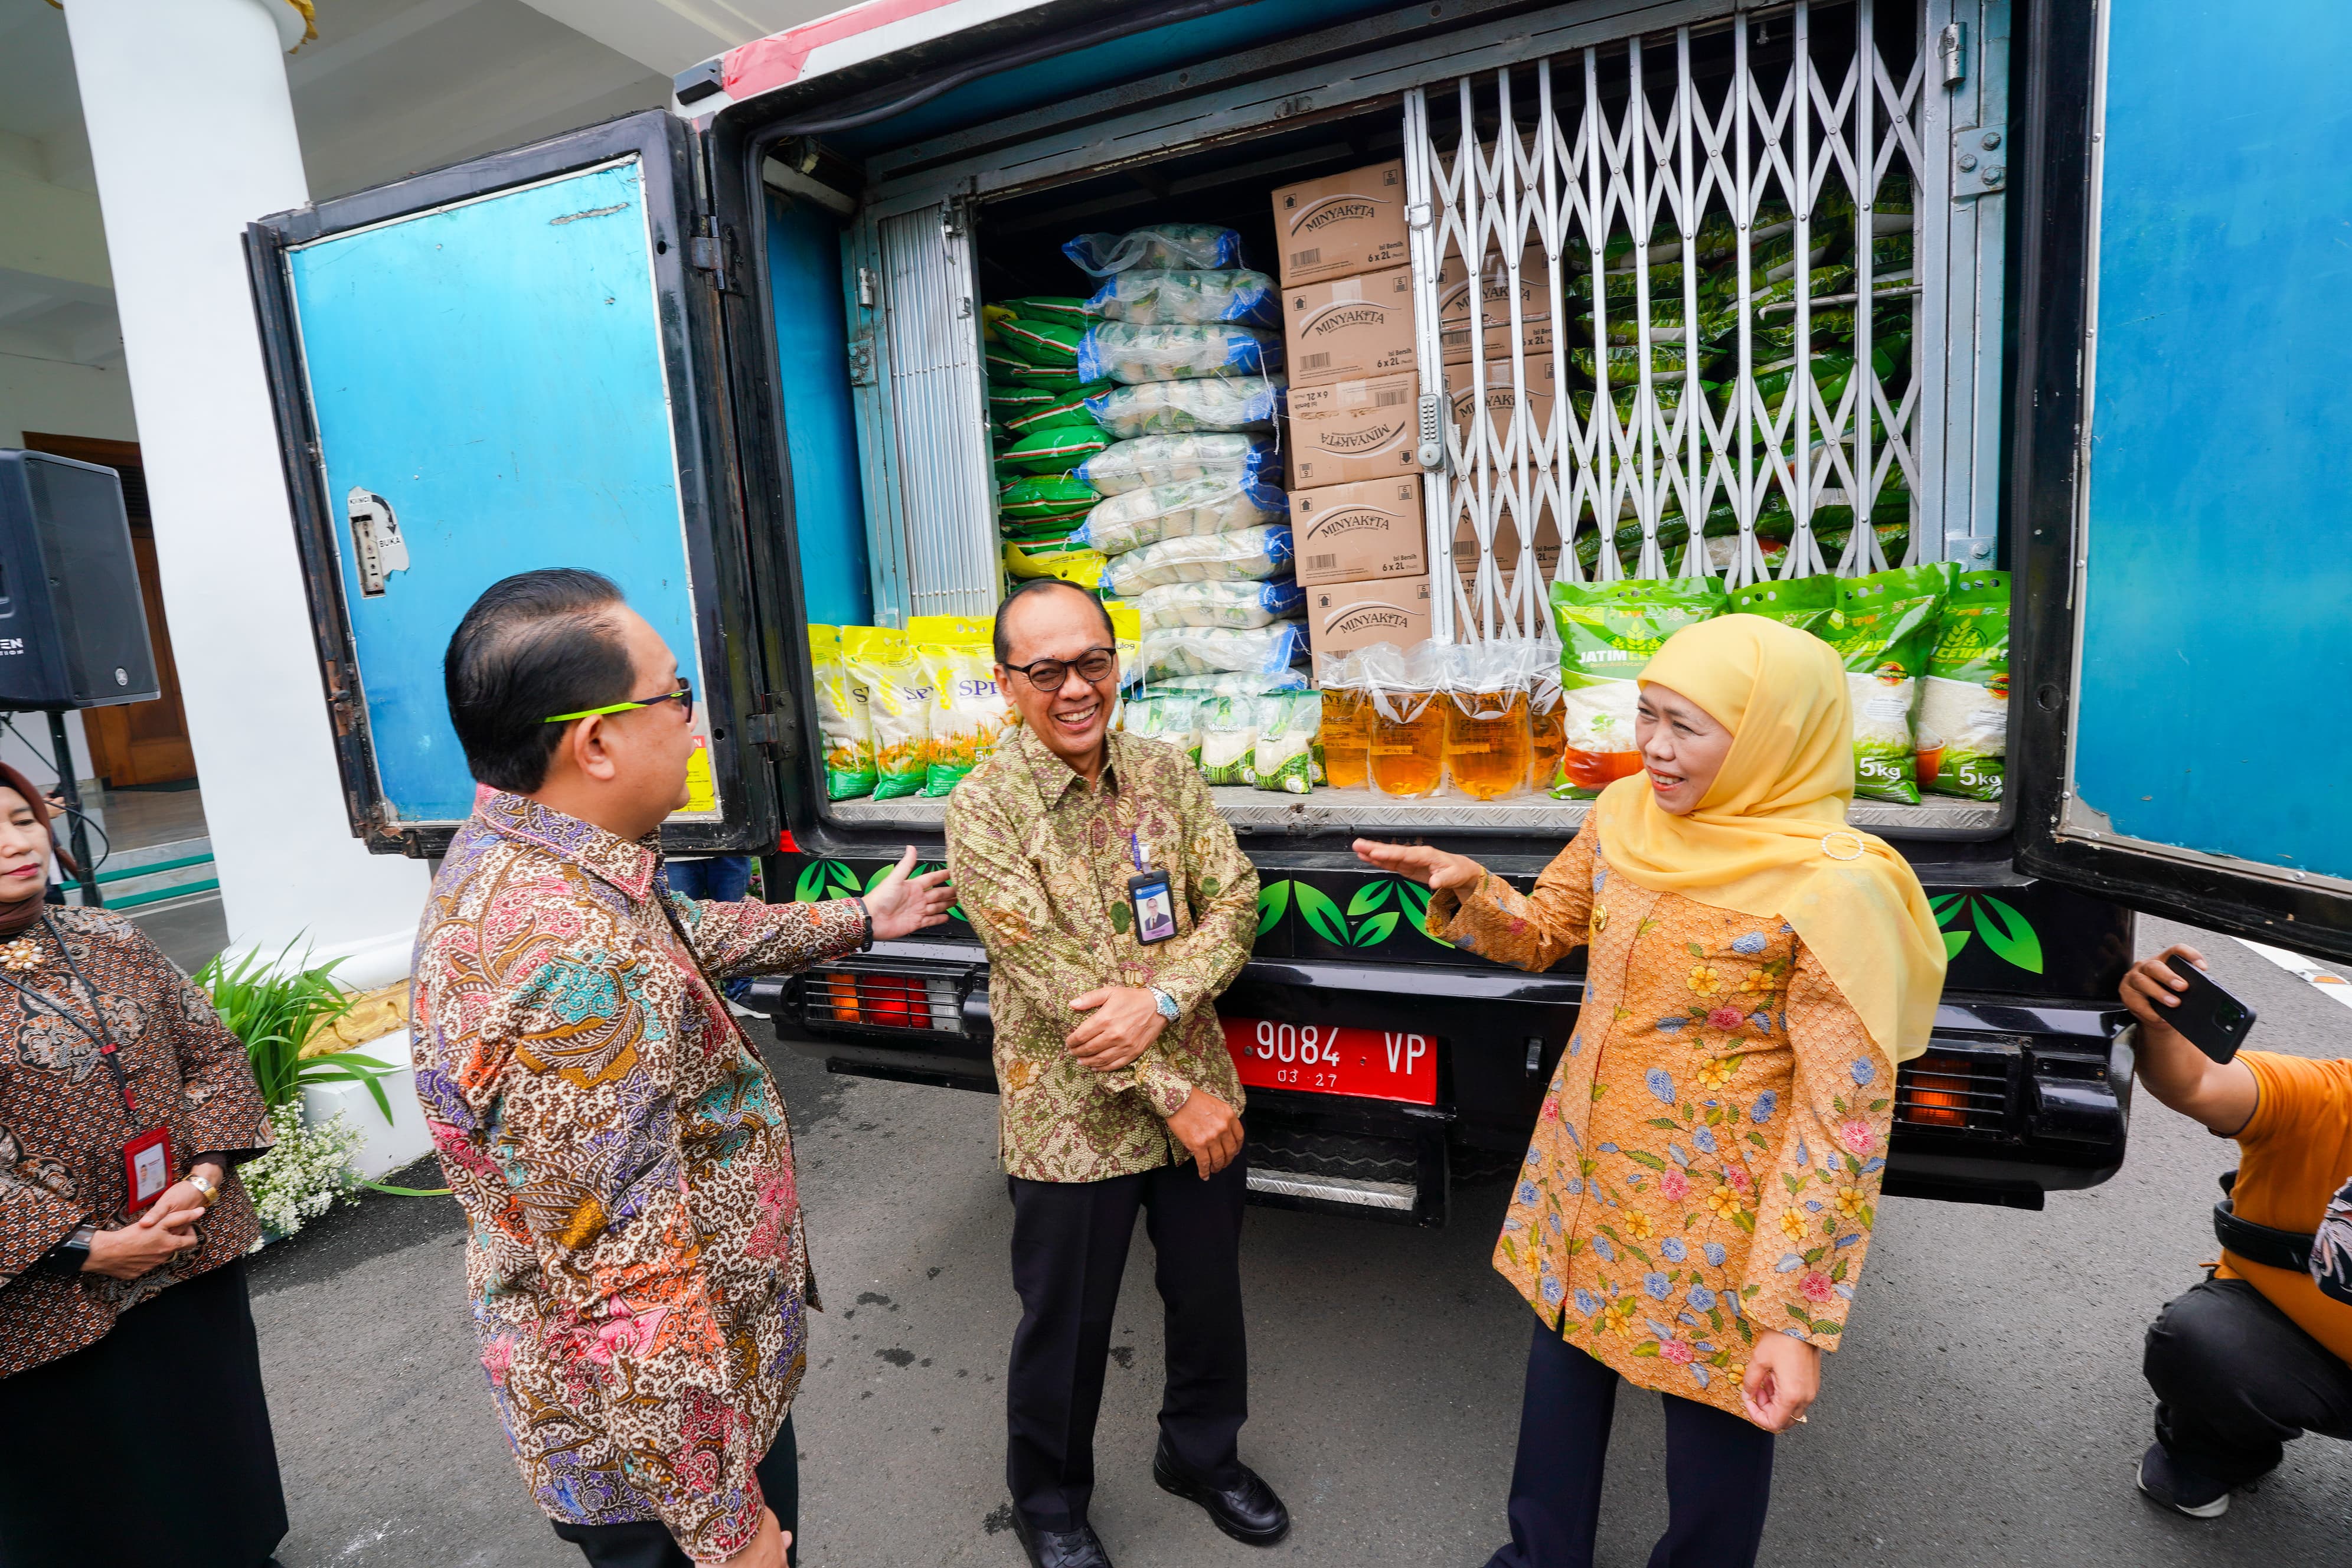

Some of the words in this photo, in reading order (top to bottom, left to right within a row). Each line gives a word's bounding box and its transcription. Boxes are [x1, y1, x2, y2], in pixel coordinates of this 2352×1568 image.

[1305, 205, 1375, 232] MINYAKITA
[1368, 254, 1373, 262] 6
[1381, 251, 1390, 260] 2L
[1455, 286, 1531, 311] MIYAKA
[1315, 310, 1384, 336] MINYAKITA
[1535, 335, 1545, 345] 2L
[1377, 360, 1383, 368] 6
[1390, 357, 1400, 366] 2L
[1306, 393, 1315, 401] 2L
[1321, 424, 1391, 447] MINYAKITA
[1321, 514, 1389, 538] MINYAKITA
[1340, 613, 1408, 634] MINYAKITA
[1859, 757, 1901, 780] 5kg
[1959, 766, 2002, 786] 5kg
[1256, 1021, 1340, 1067] 9084
[1384, 1031, 1426, 1075] VP
[1278, 1069, 1298, 1083] 03
[1315, 1073, 1337, 1087] 27
